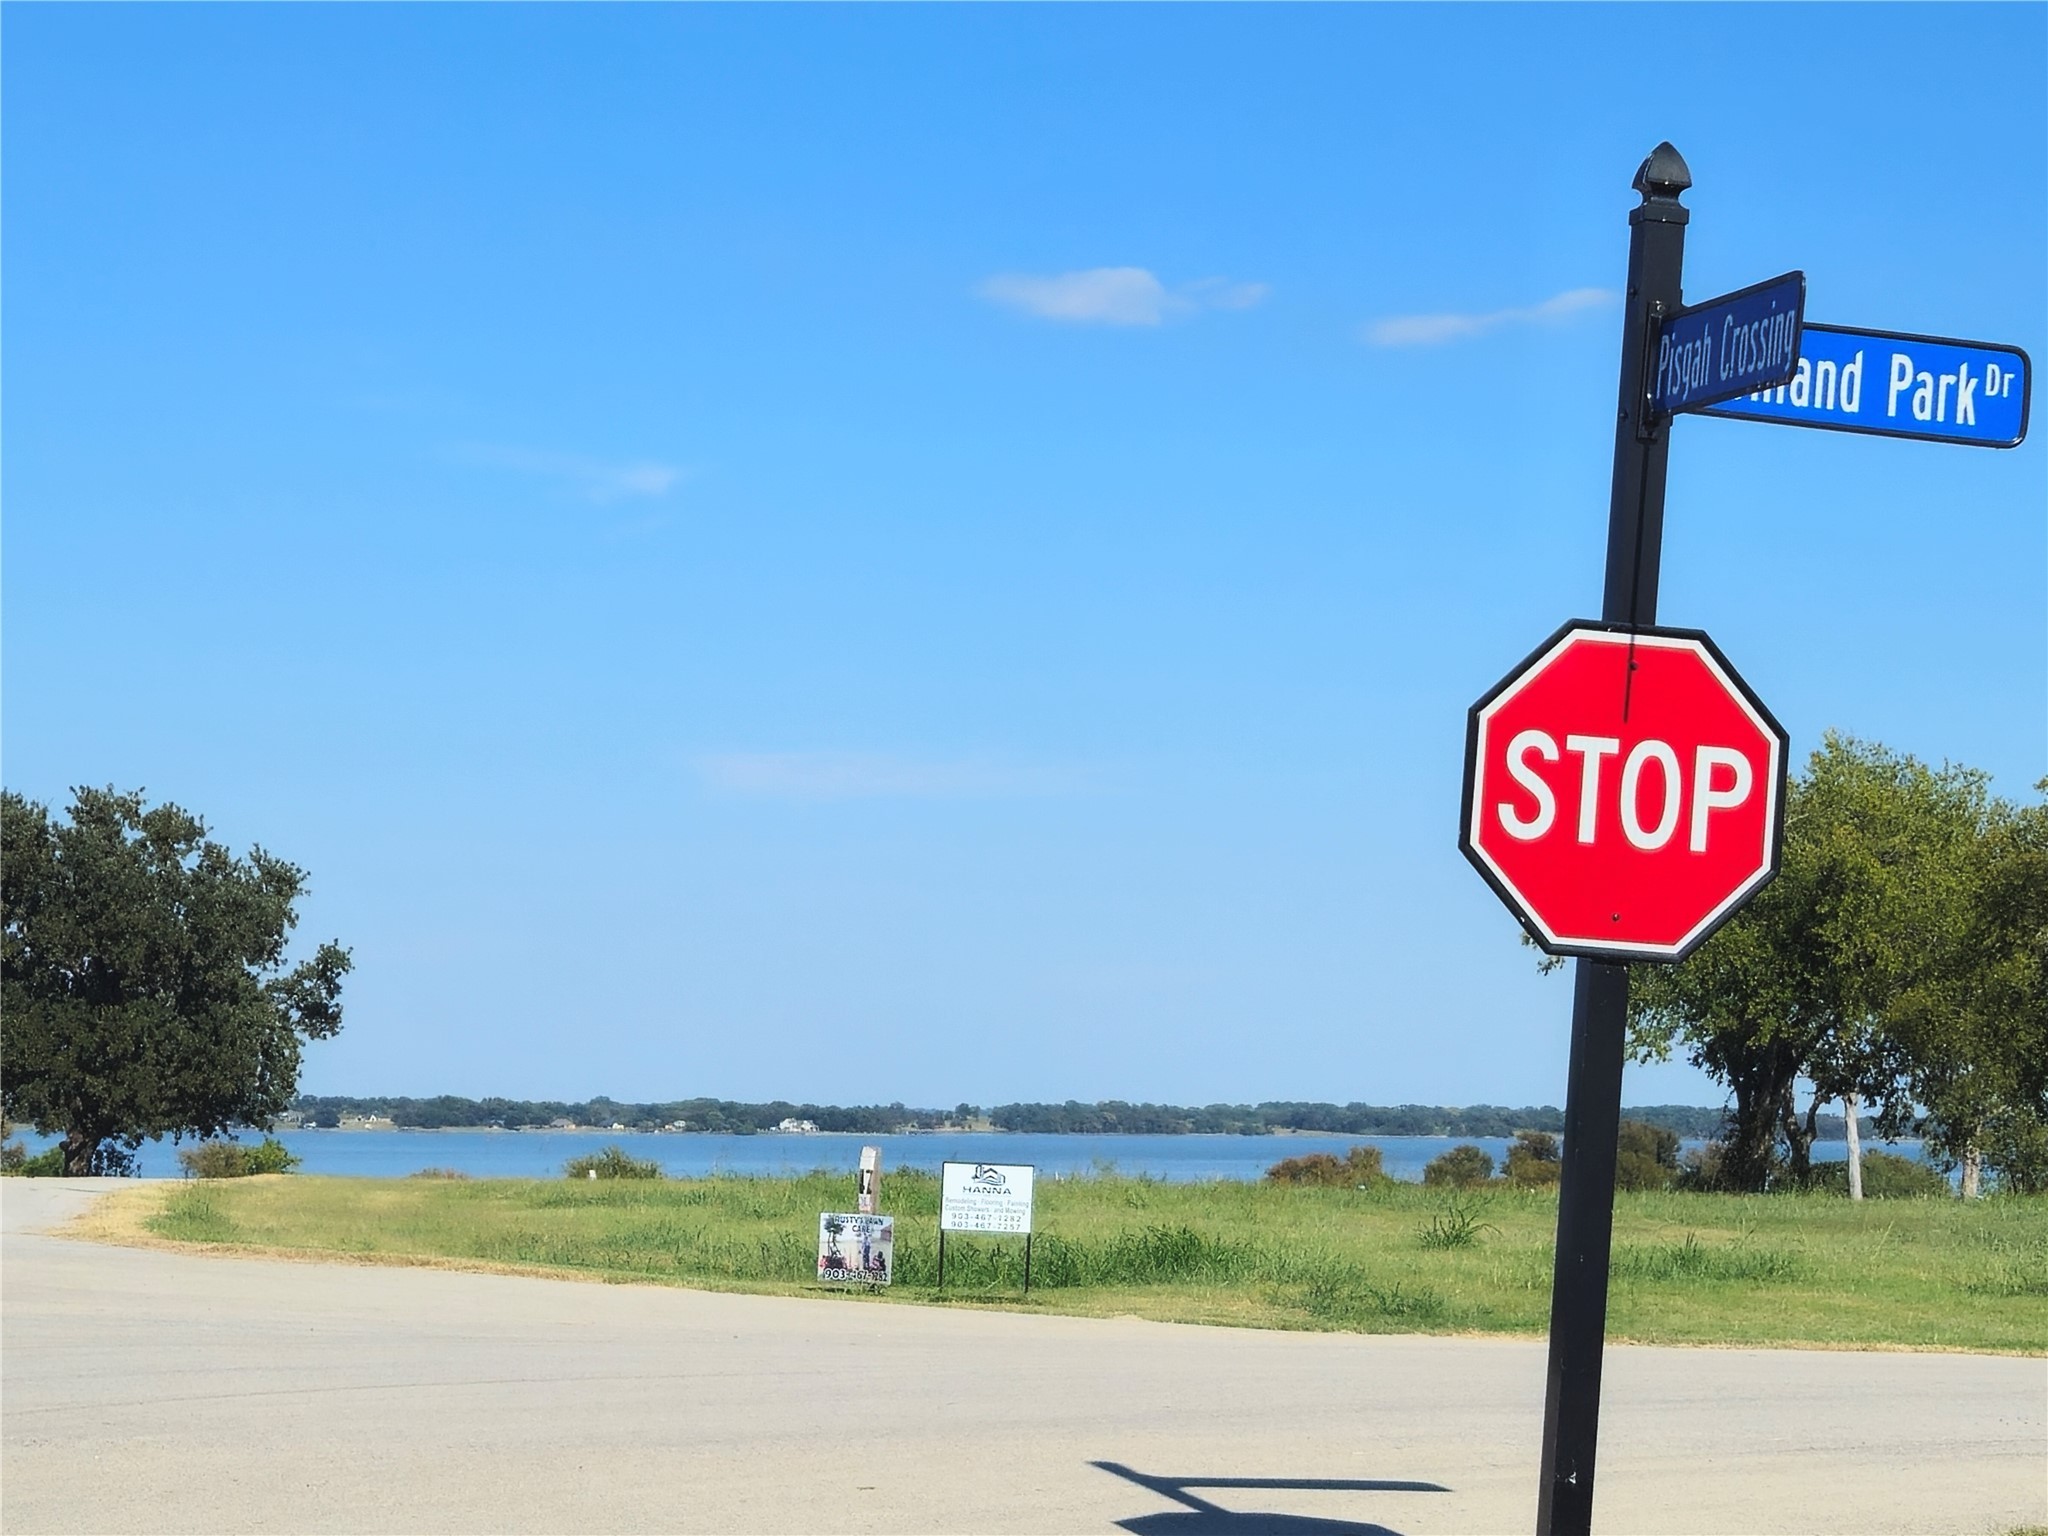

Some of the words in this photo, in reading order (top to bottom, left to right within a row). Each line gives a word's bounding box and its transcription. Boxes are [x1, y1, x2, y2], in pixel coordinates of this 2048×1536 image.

[1656, 323, 1712, 401] Pisgah
[1720, 300, 1796, 383] Crossing
[1887, 353, 1981, 426] Park
[1985, 362, 2015, 398] Dr
[1497, 728, 1753, 854] STOP
[962, 1186, 1012, 1195] HANNA
[851, 1224, 870, 1233] CARE
